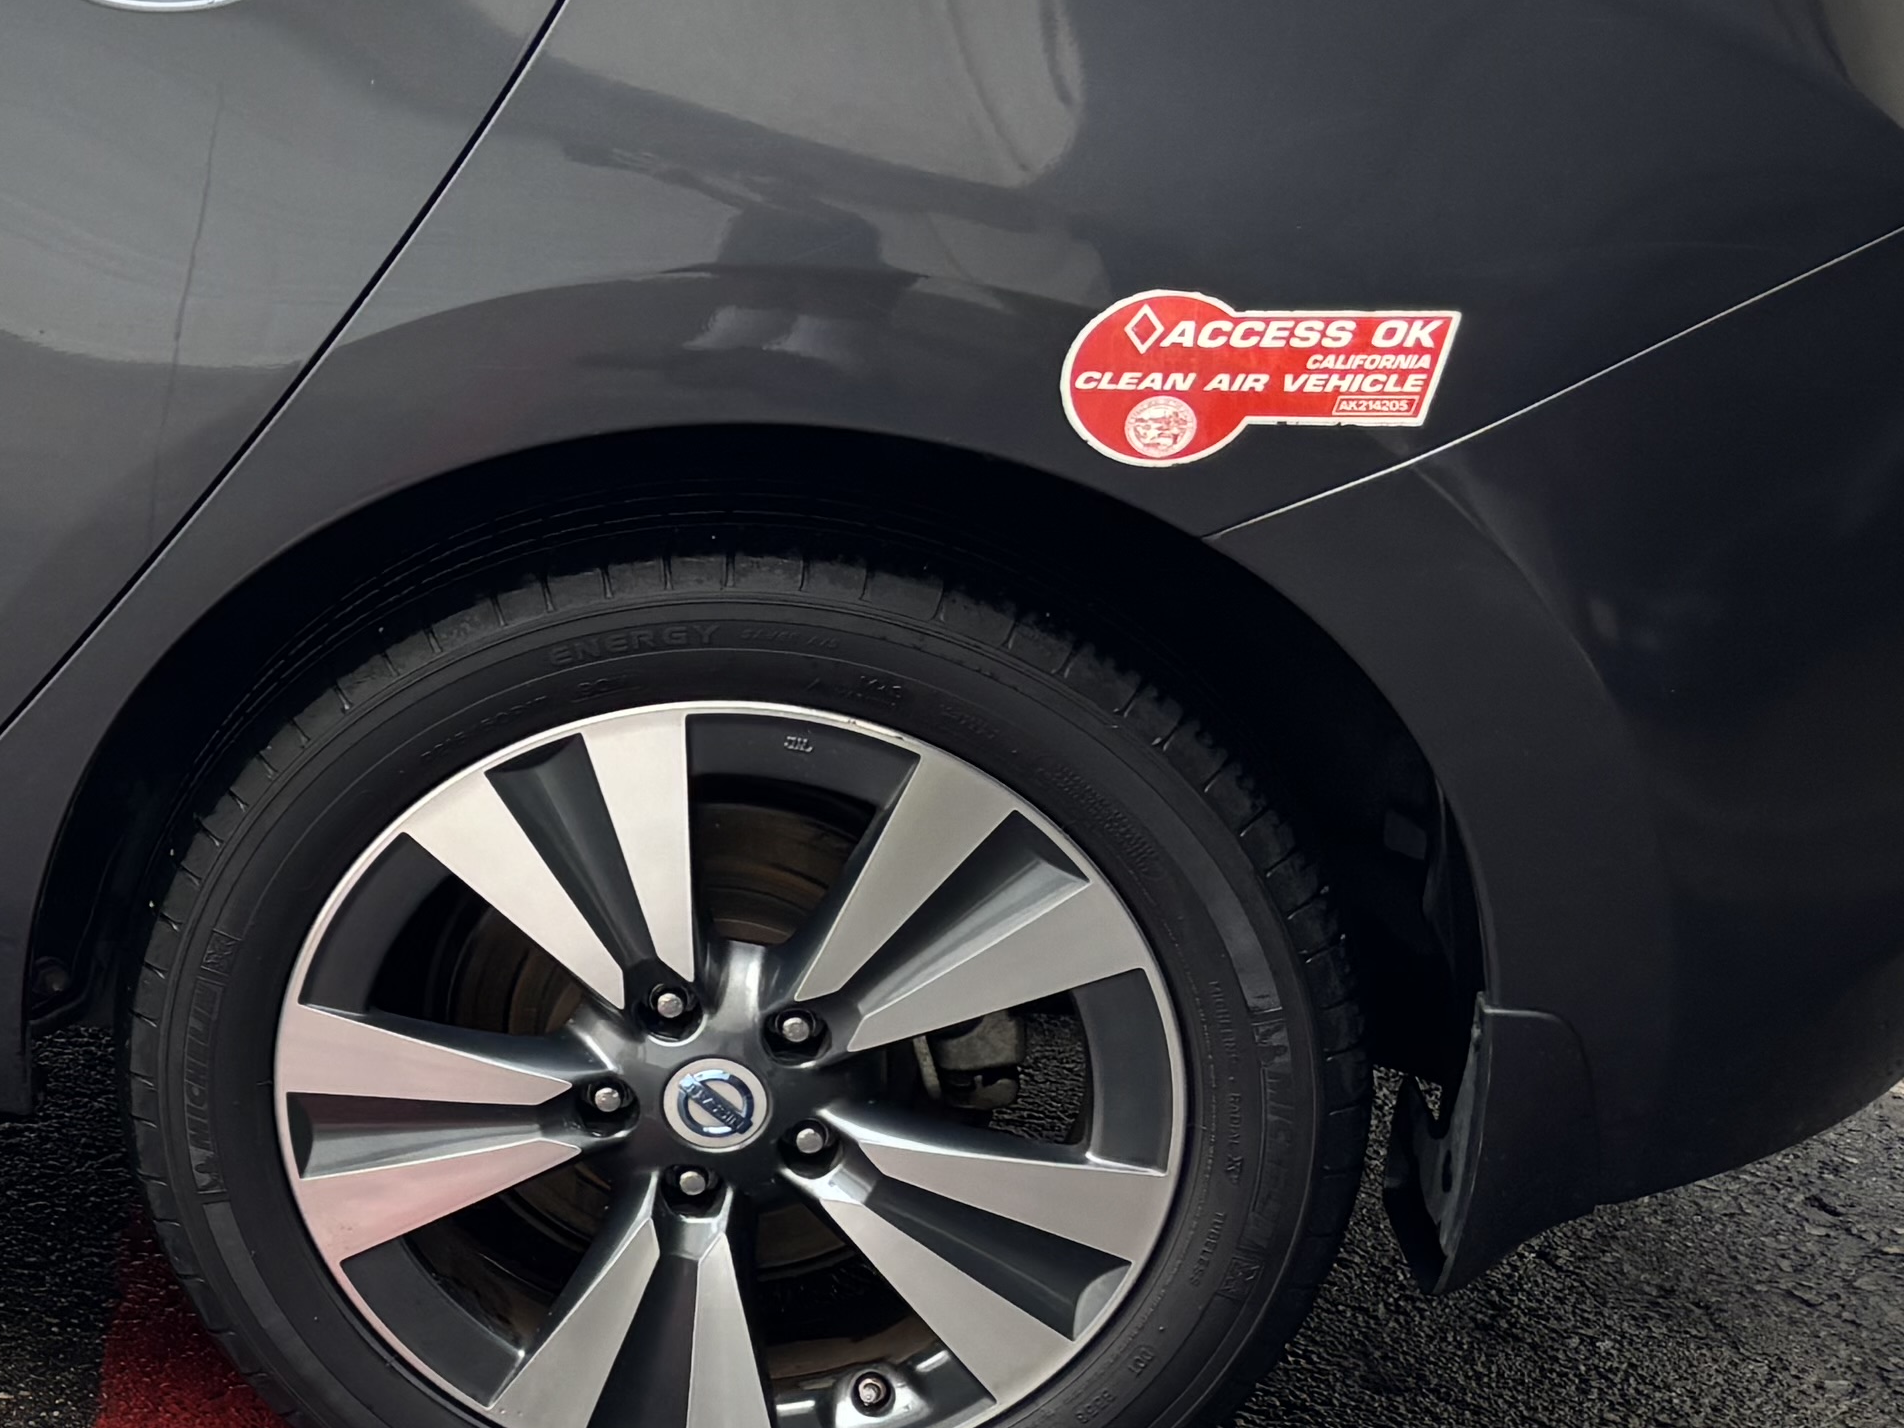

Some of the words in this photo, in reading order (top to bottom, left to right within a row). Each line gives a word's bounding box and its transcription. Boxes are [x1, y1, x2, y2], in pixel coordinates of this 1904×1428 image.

[1160, 320, 1357, 349] ACCESS
[1370, 319, 1437, 349] OK
[1305, 353, 1433, 370] CALIFORNIA
[1074, 370, 1197, 392] CLEAN
[1203, 372, 1269, 393] AIR
[1282, 373, 1428, 393] VEHICLE
[1338, 399, 1410, 412] AK214205
[547, 623, 722, 668] ENERGY
